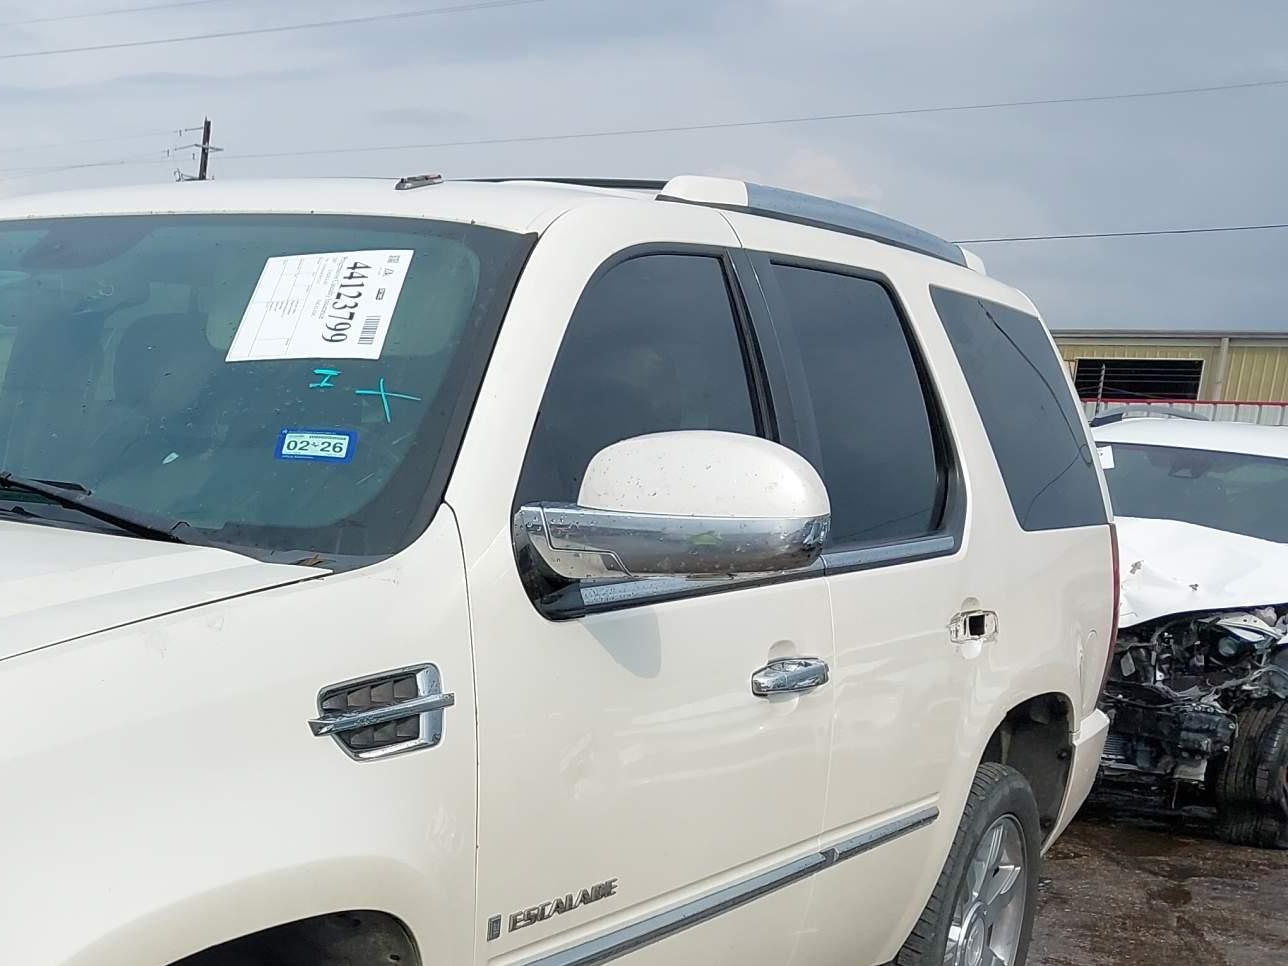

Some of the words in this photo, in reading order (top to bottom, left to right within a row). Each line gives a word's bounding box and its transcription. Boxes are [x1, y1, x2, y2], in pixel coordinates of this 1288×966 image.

[321, 261, 372, 343] 44123799
[286, 440, 310, 451] 02
[320, 441, 344, 454] 26
[508, 878, 618, 933] ESCALADE
